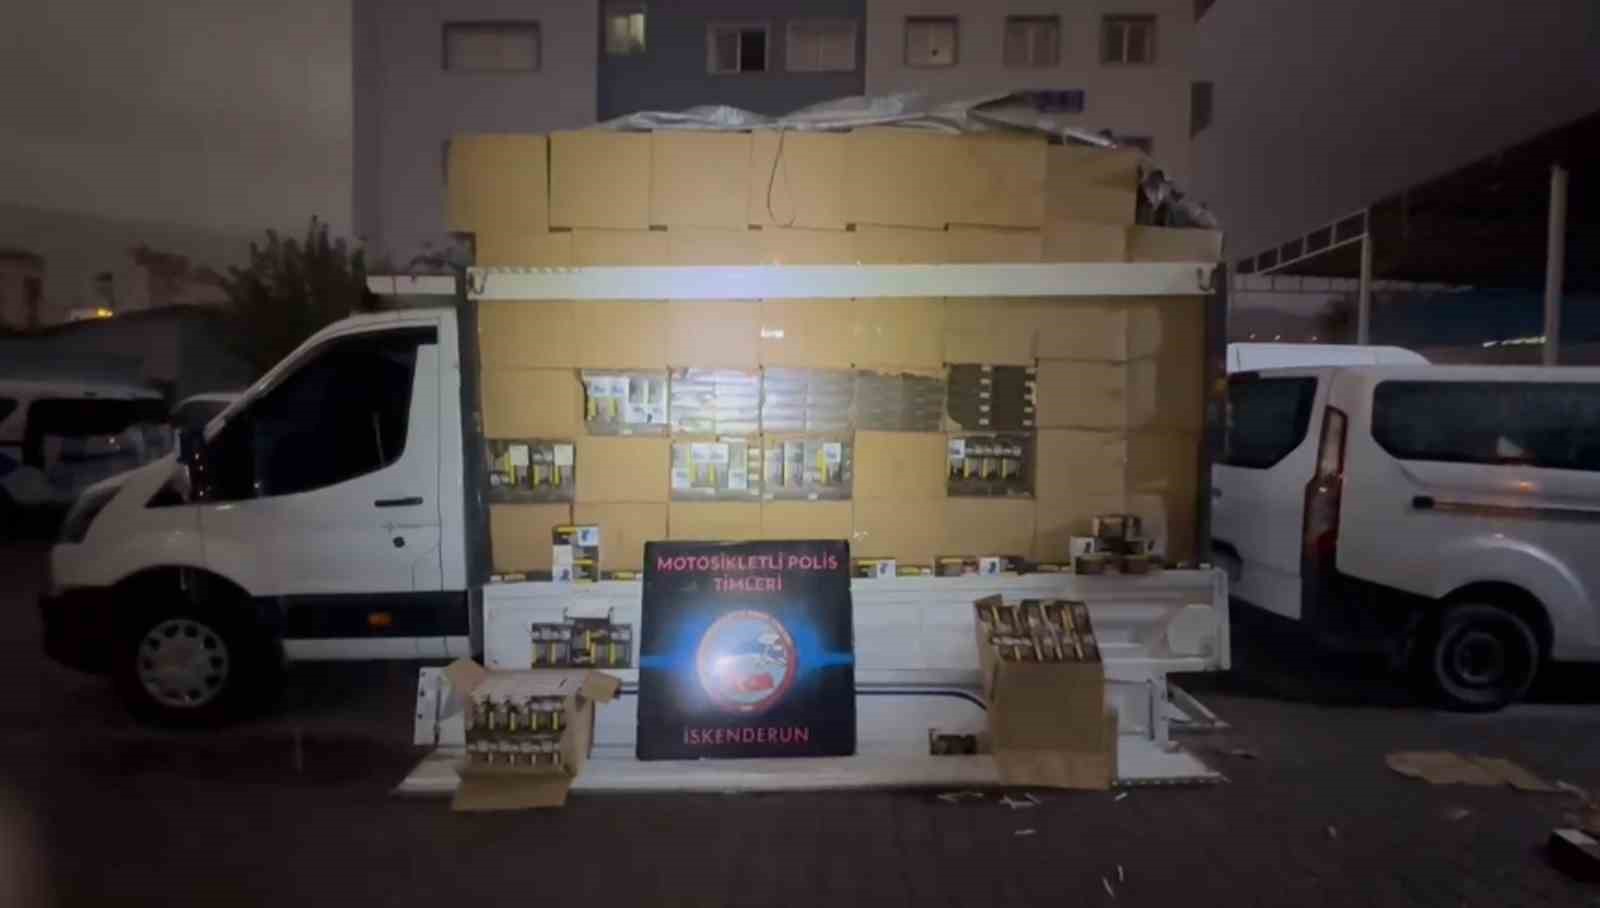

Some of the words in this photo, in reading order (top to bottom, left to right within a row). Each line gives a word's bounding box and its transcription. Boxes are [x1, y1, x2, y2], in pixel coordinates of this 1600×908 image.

[657, 553, 783, 571] MOTOSİKLETLİ
[788, 553, 838, 570] POLİS
[714, 575, 783, 592] TİMLERİ
[683, 726, 809, 745] İSKENDERUN
